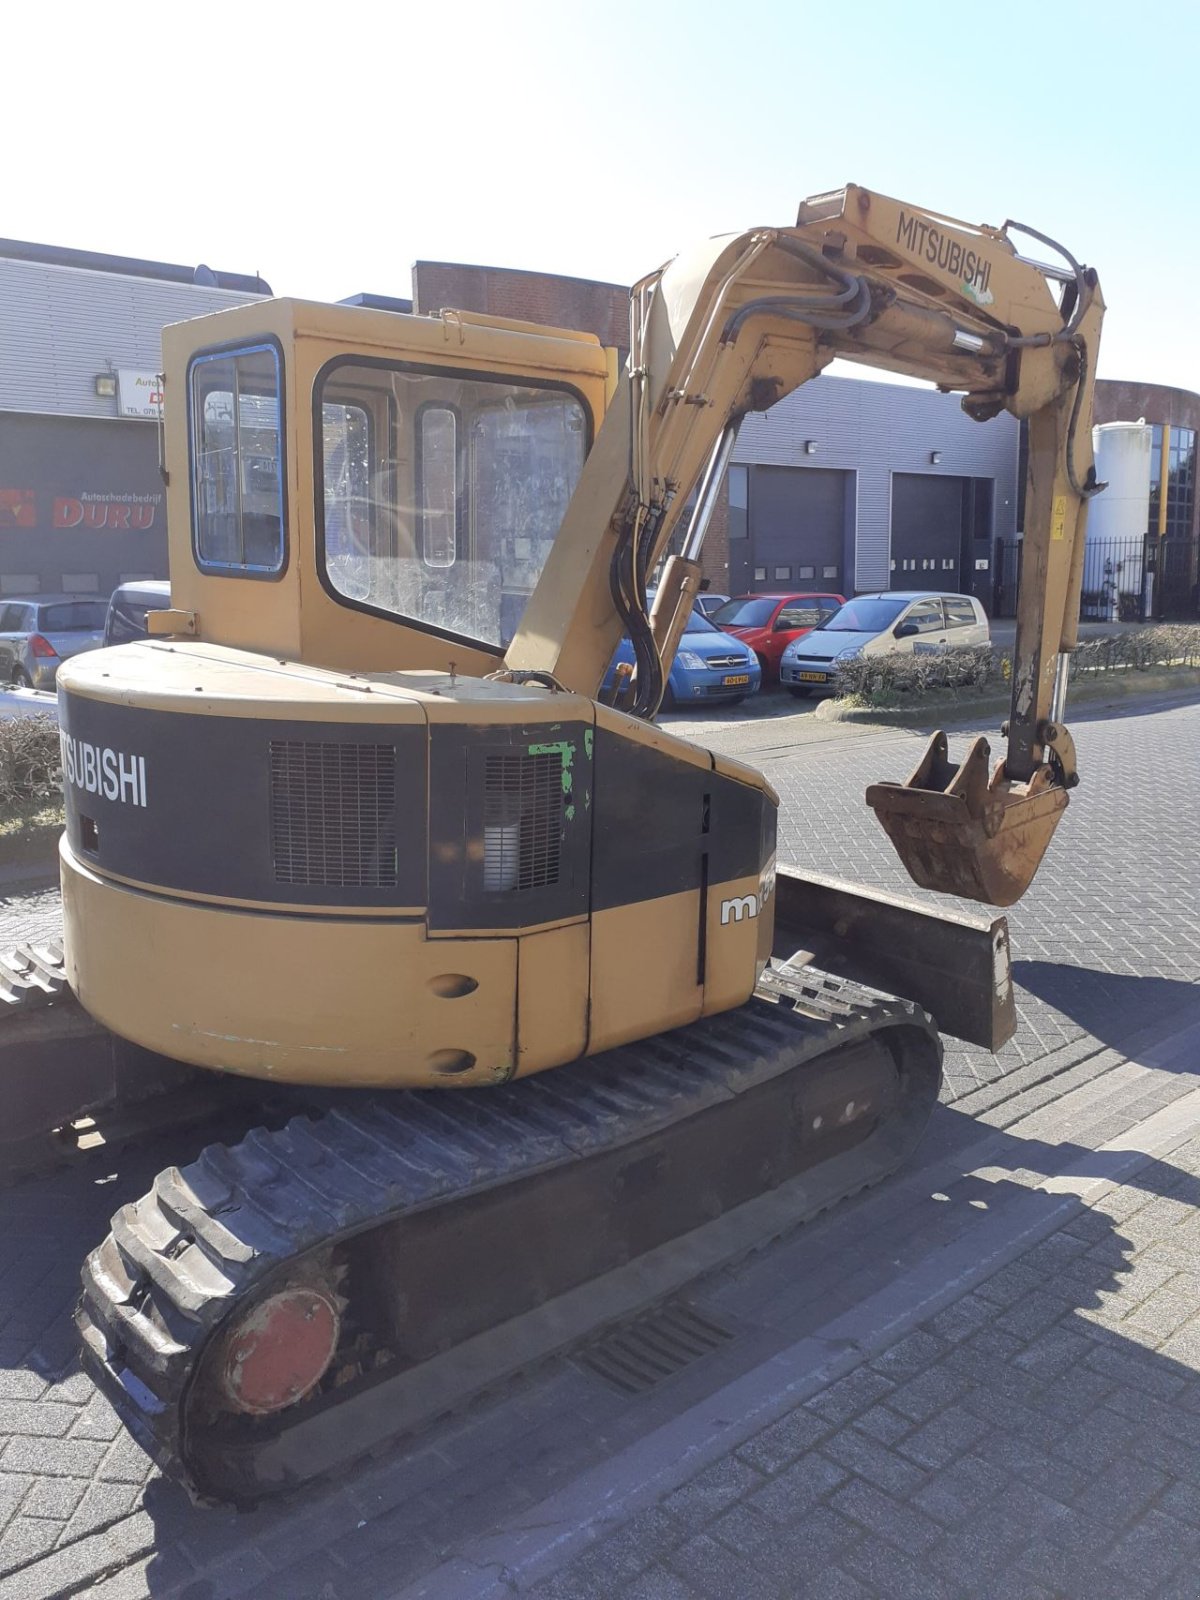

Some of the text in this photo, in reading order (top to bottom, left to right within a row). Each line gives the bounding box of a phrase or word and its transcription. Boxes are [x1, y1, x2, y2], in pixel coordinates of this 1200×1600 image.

[896, 211, 992, 293] MITSUBISHI
[52, 497, 155, 529] DURU
[81, 491, 162, 505] Autoschadebedrijf
